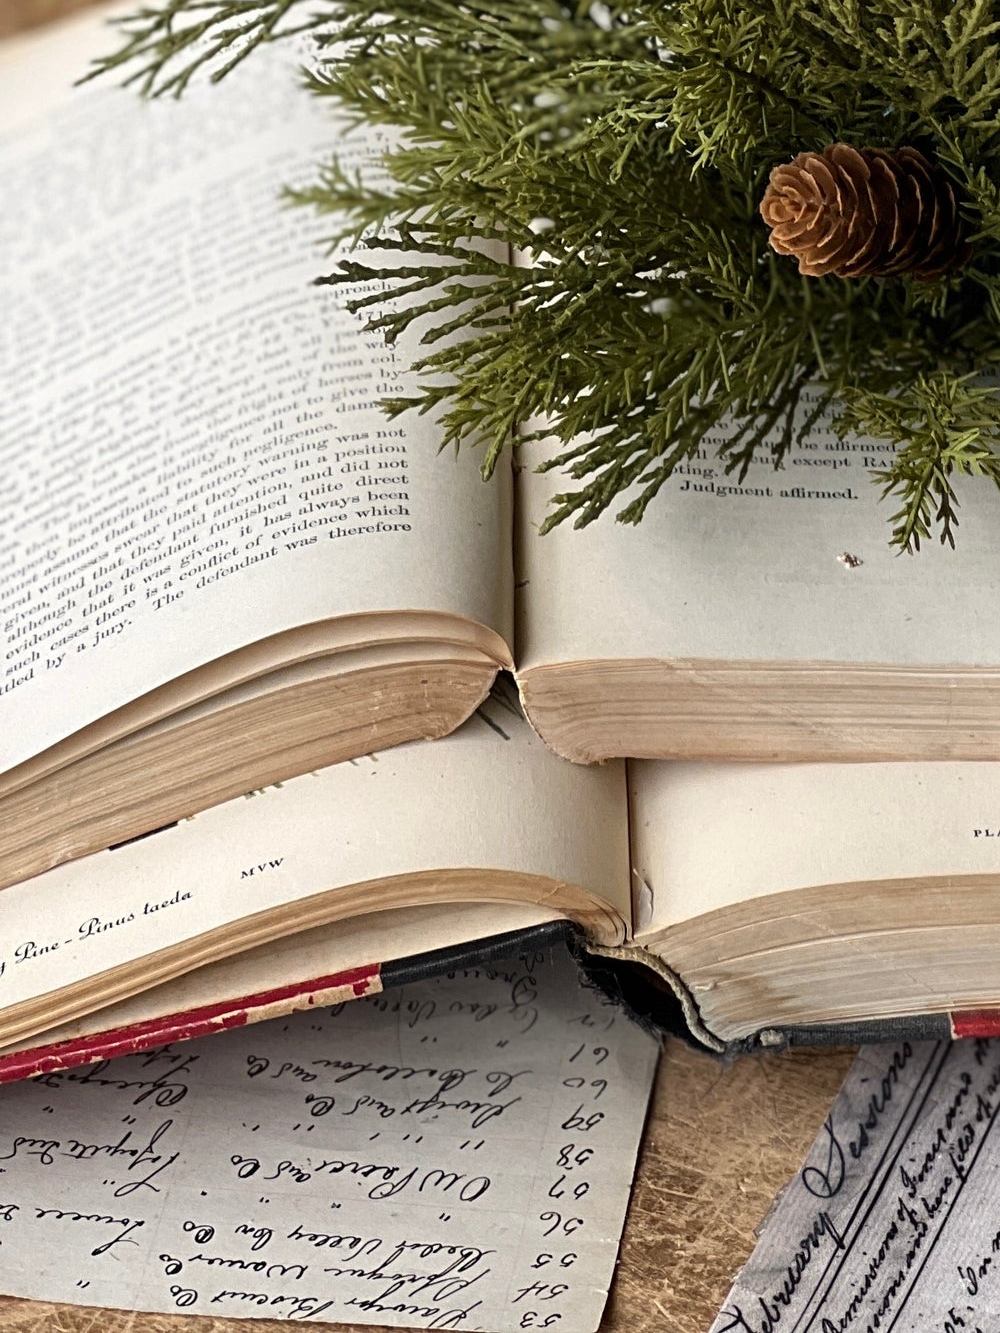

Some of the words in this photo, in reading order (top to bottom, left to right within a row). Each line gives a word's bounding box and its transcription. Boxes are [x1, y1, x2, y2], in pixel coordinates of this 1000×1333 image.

[331, 387, 369, 402] give
[376, 383, 404, 393] the
[263, 419, 284, 434] all
[297, 410, 324, 423] the
[201, 456, 236, 477] such
[243, 423, 338, 459] negligence.
[793, 457, 852, 469] except
[105, 520, 137, 543] that
[143, 505, 168, 522] the
[176, 464, 251, 504] statutory
[258, 439, 329, 466] warning
[336, 432, 369, 443] was
[376, 429, 406, 438] not
[115, 523, 160, 553] swear
[167, 504, 199, 525] that
[205, 483, 242, 506] they
[247, 466, 287, 486] were
[294, 459, 309, 469] in
[335, 444, 407, 462] position
[680, 480, 774, 497] Judgment
[781, 487, 859, 500] affirmed.
[4, 602, 51, 633] given,
[57, 577, 86, 600] and
[93, 560, 125, 580] that
[131, 536, 166, 560] they
[173, 514, 206, 541] paid
[213, 482, 293, 517] attention,
[301, 467, 333, 483] and
[340, 461, 369, 474] did
[378, 460, 409, 469] not
[7, 600, 77, 644] although
[88, 580, 113, 598] the
[120, 534, 200, 581] defendant
[209, 495, 287, 535] furnished
[299, 483, 343, 501] quite
[355, 475, 409, 487] direct
[5, 618, 73, 659] evidence
[82, 594, 115, 617] that
[123, 583, 136, 596] it
[143, 565, 172, 584] was
[180, 540, 229, 568] given,
[240, 527, 252, 537] it
[264, 511, 292, 527] has
[299, 496, 360, 515] always
[368, 490, 409, 501] been
[5, 651, 40, 676] such
[50, 625, 89, 651] cases
[95, 600, 136, 626] there
[145, 588, 158, 600] is
[164, 581, 173, 589] a
[179, 547, 240, 581] conflict
[245, 534, 263, 549] of
[272, 514, 348, 539] evidence
[355, 505, 410, 518] which
[46, 653, 66, 670] by
[77, 643, 86, 652] a
[93, 621, 132, 647] jury.
[152, 590, 184, 611] The
[196, 547, 278, 589] defendant
[284, 535, 318, 552] was
[329, 521, 411, 539] therefore
[240, 857, 285, 880] MVW
[14, 941, 60, 965] Pine
[77, 912, 136, 941] Pinus
[142, 890, 194, 916] taeda
[563, 1076, 607, 1097] 60
[561, 1103, 605, 1131] 59
[556, 1144, 593, 1170] 58
[540, 1212, 583, 1236] 56
[530, 1253, 577, 1269] 55
[512, 1281, 568, 1302] 54
[520, 1312, 561, 1327] 53
